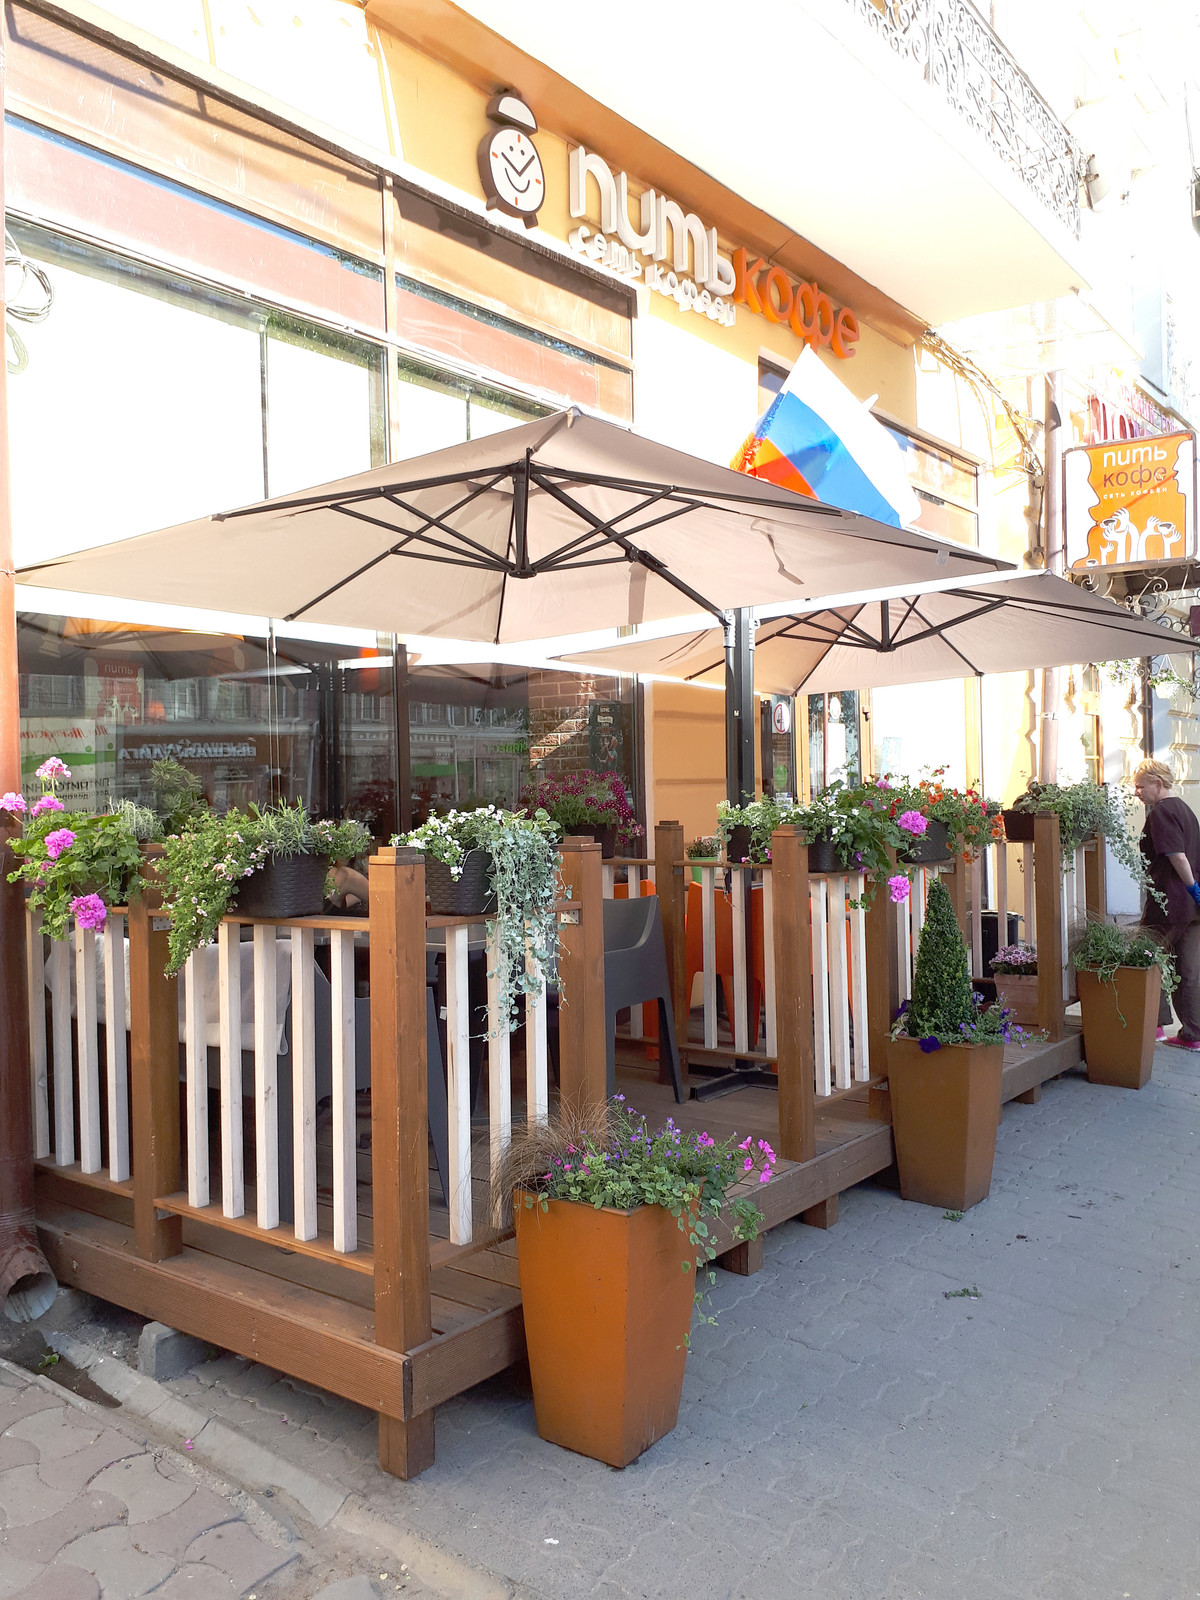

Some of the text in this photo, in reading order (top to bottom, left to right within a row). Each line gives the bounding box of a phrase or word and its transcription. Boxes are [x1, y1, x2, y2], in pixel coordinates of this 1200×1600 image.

[645, 263, 736, 327] кофеен
[733, 247, 860, 359] кофе
[1103, 445, 1168, 468] пить
[1103, 465, 1167, 489] кофе
